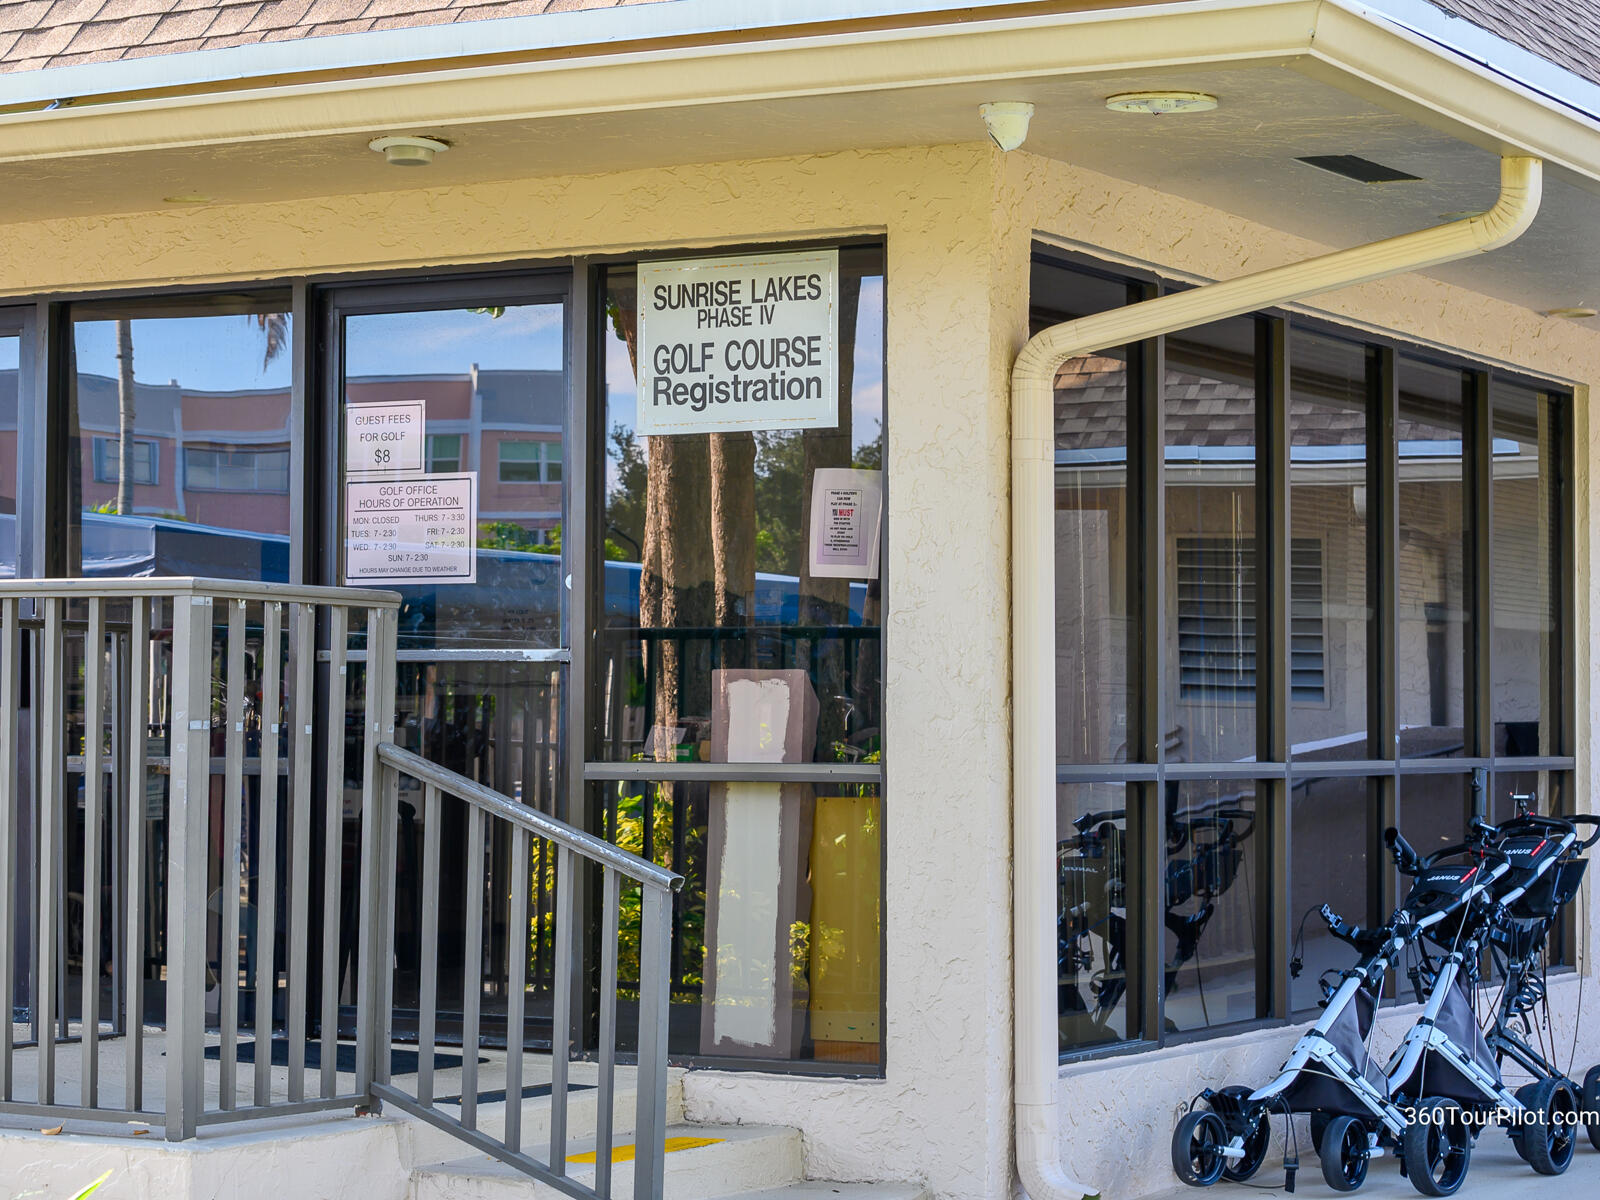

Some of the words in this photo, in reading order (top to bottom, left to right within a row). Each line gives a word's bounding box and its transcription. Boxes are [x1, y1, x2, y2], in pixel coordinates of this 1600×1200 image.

[653, 280, 742, 311] SUNRISE
[751, 273, 822, 304] LAKES
[697, 306, 752, 329] PHASE
[760, 304, 775, 325] IV
[653, 342, 714, 375] GOLF
[724, 335, 822, 371] COURSE
[653, 370, 822, 412] Registration
[355, 415, 385, 425] GUEST
[388, 414, 411, 424] FEES
[360, 432, 379, 442] FOR
[381, 431, 406, 441] GOLF
[374, 448, 390, 466] $8
[379, 486, 403, 496] GOLF
[405, 485, 438, 495] OFFICE
[359, 498, 391, 508] HOURS
[393, 498, 405, 507] OF
[407, 496, 459, 506] OPERATION
[838, 508, 854, 517] MUST
[372, 516, 400, 524] CLOSED
[383, 529, 397, 537] 2:30
[450, 527, 465, 535] 2:30
[450, 540, 465, 548] 2:30
[414, 554, 428, 562] 2:30
